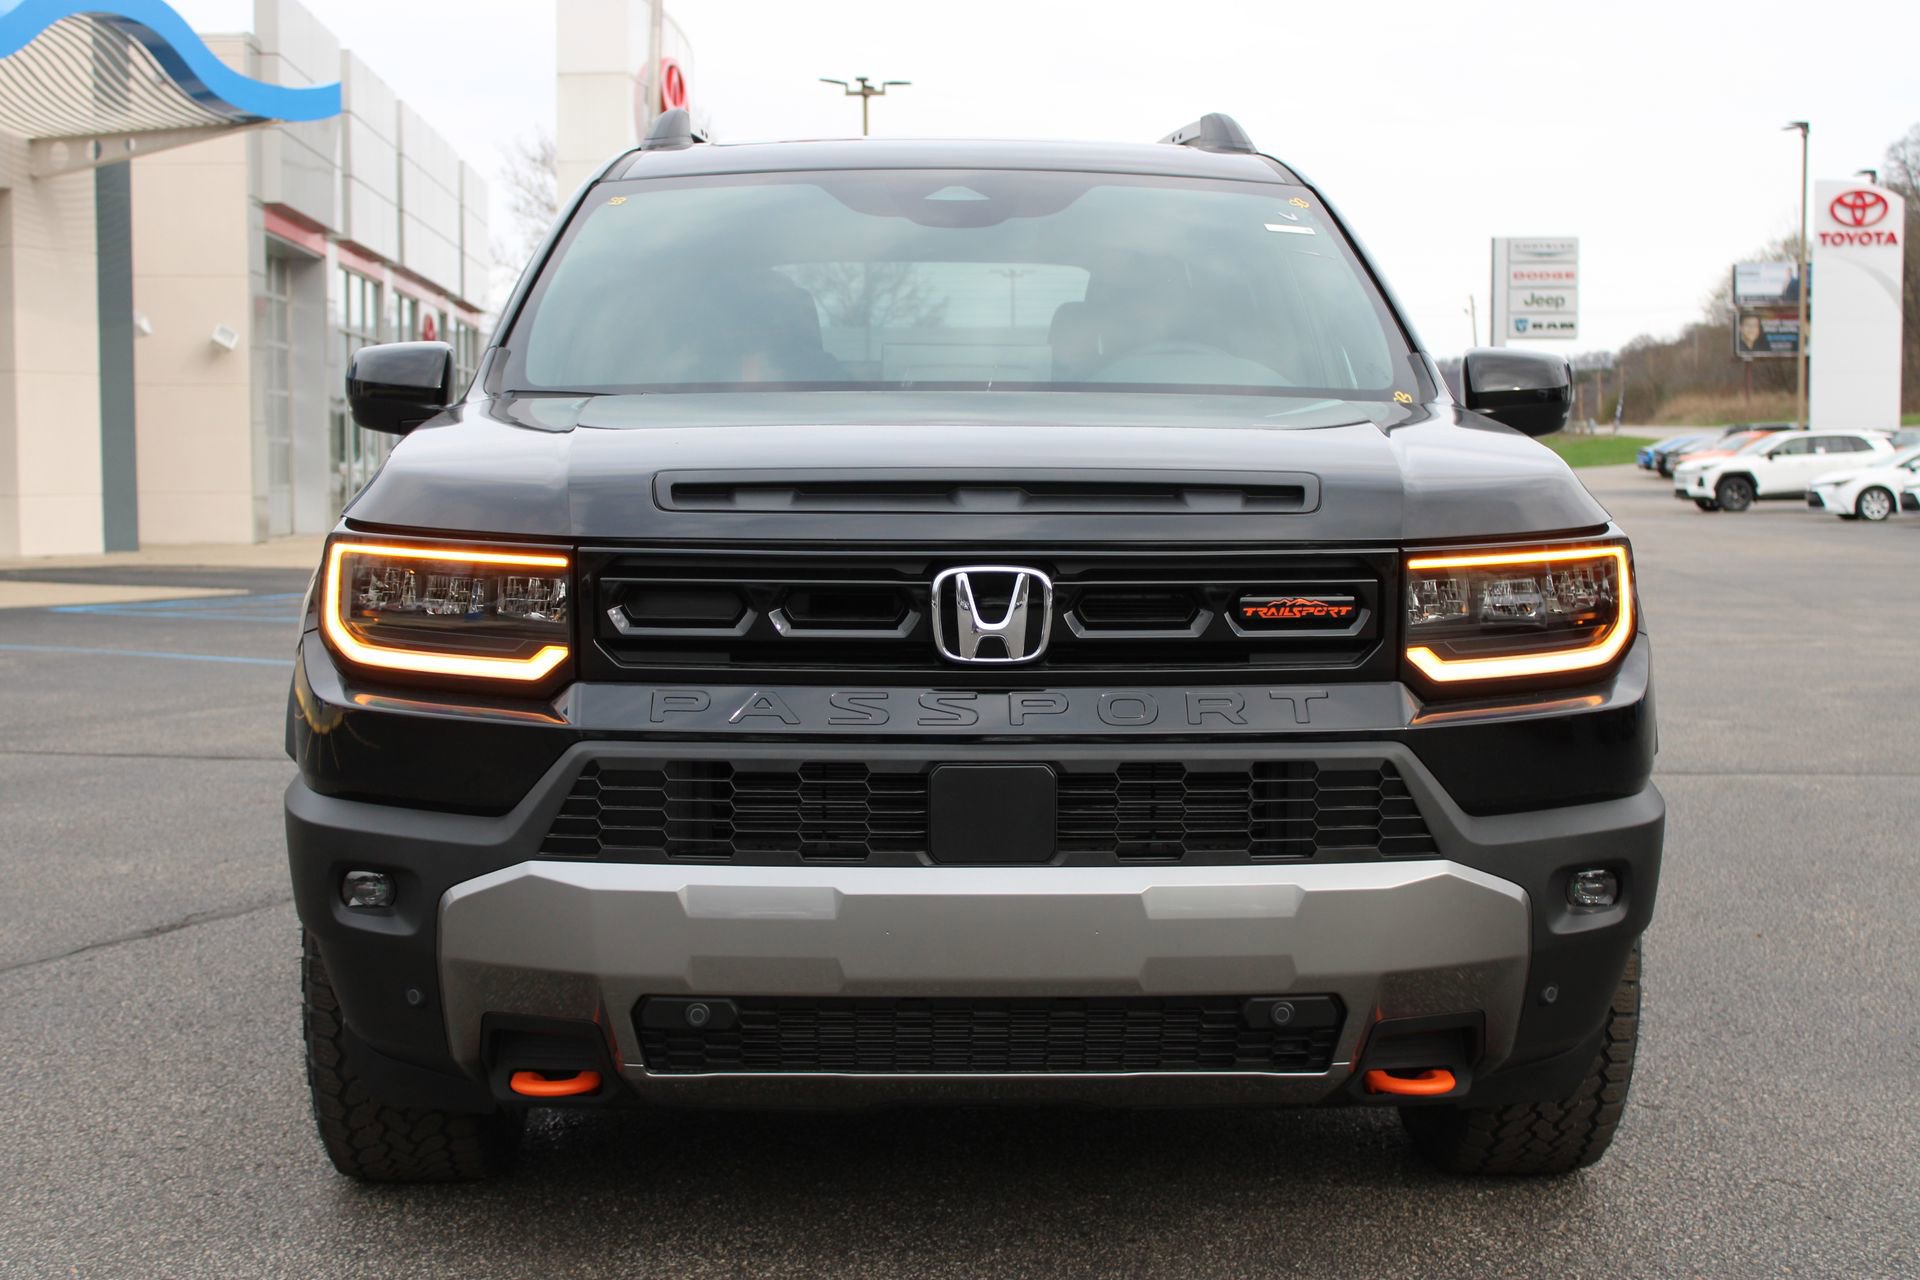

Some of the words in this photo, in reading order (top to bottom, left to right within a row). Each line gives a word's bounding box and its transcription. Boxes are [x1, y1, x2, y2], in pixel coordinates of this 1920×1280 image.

[1819, 231, 1898, 246] TOYOTA
[1523, 292, 1566, 309] Jeep
[1242, 606, 1353, 619] TRAILSPORT
[649, 688, 1329, 727] PASSPORT
